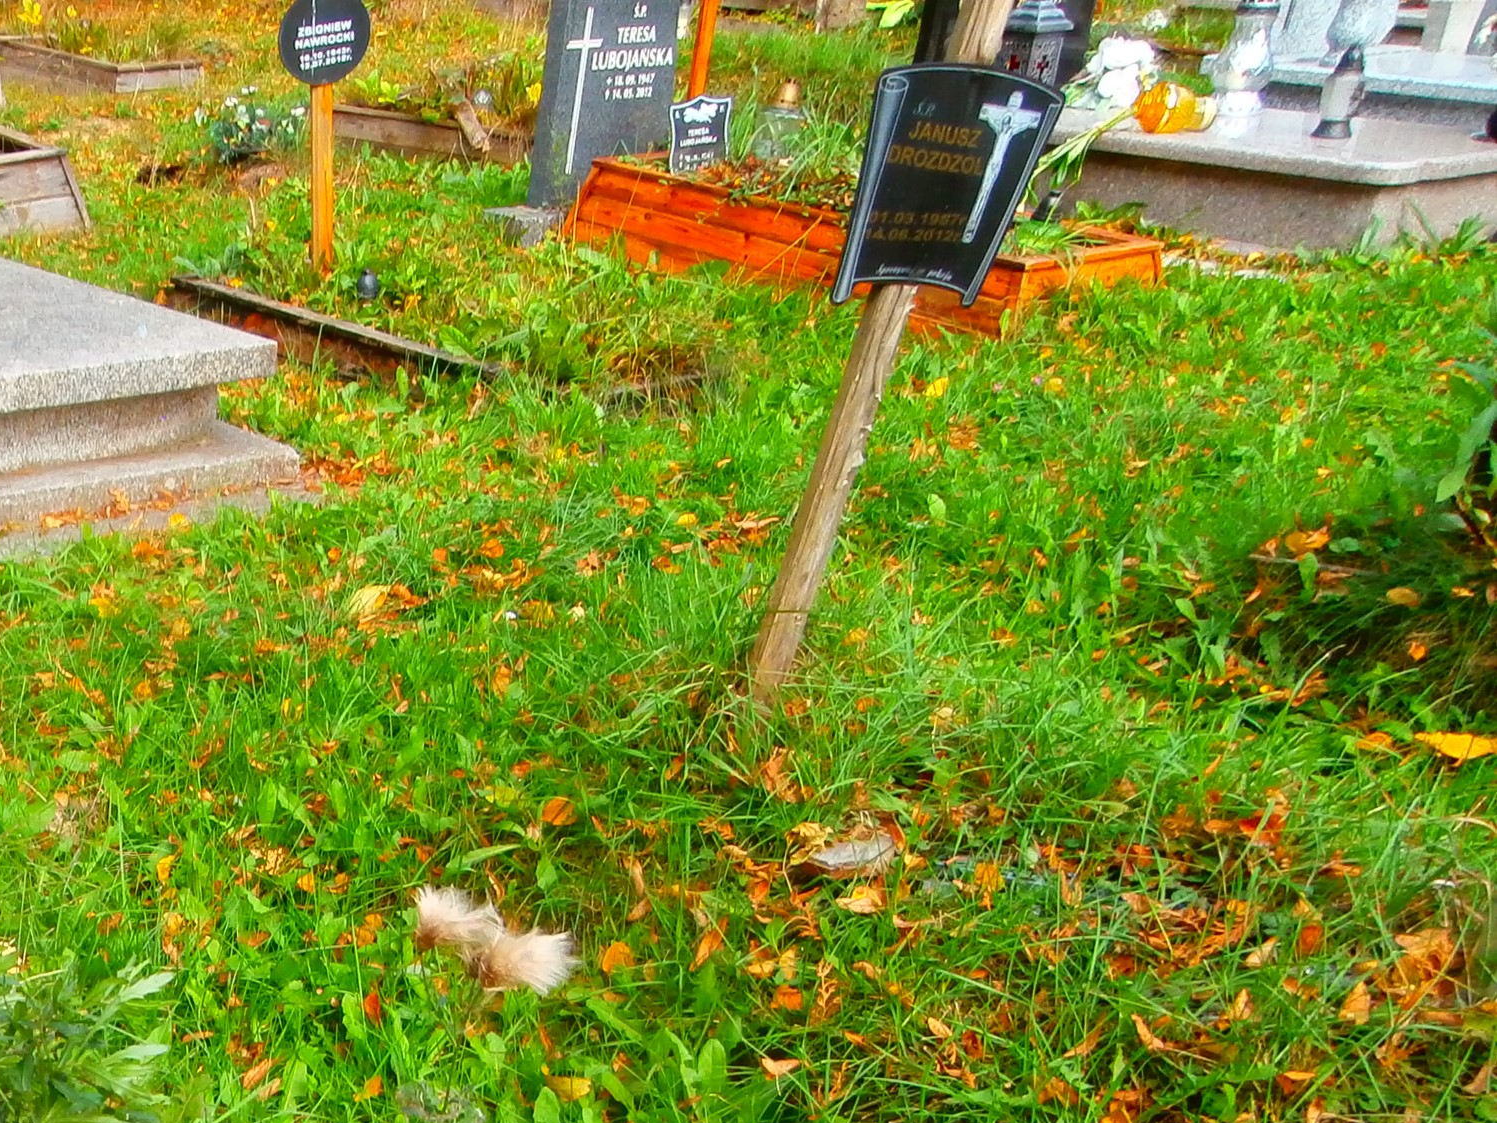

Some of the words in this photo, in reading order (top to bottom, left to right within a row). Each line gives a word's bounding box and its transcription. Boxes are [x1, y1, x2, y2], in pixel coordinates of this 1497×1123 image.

[297, 19, 353, 38] ZBIGNIEW
[617, 25, 656, 44] TERESA
[294, 31, 355, 50] NAWROCKI
[908, 120, 982, 149] JANUSZ
